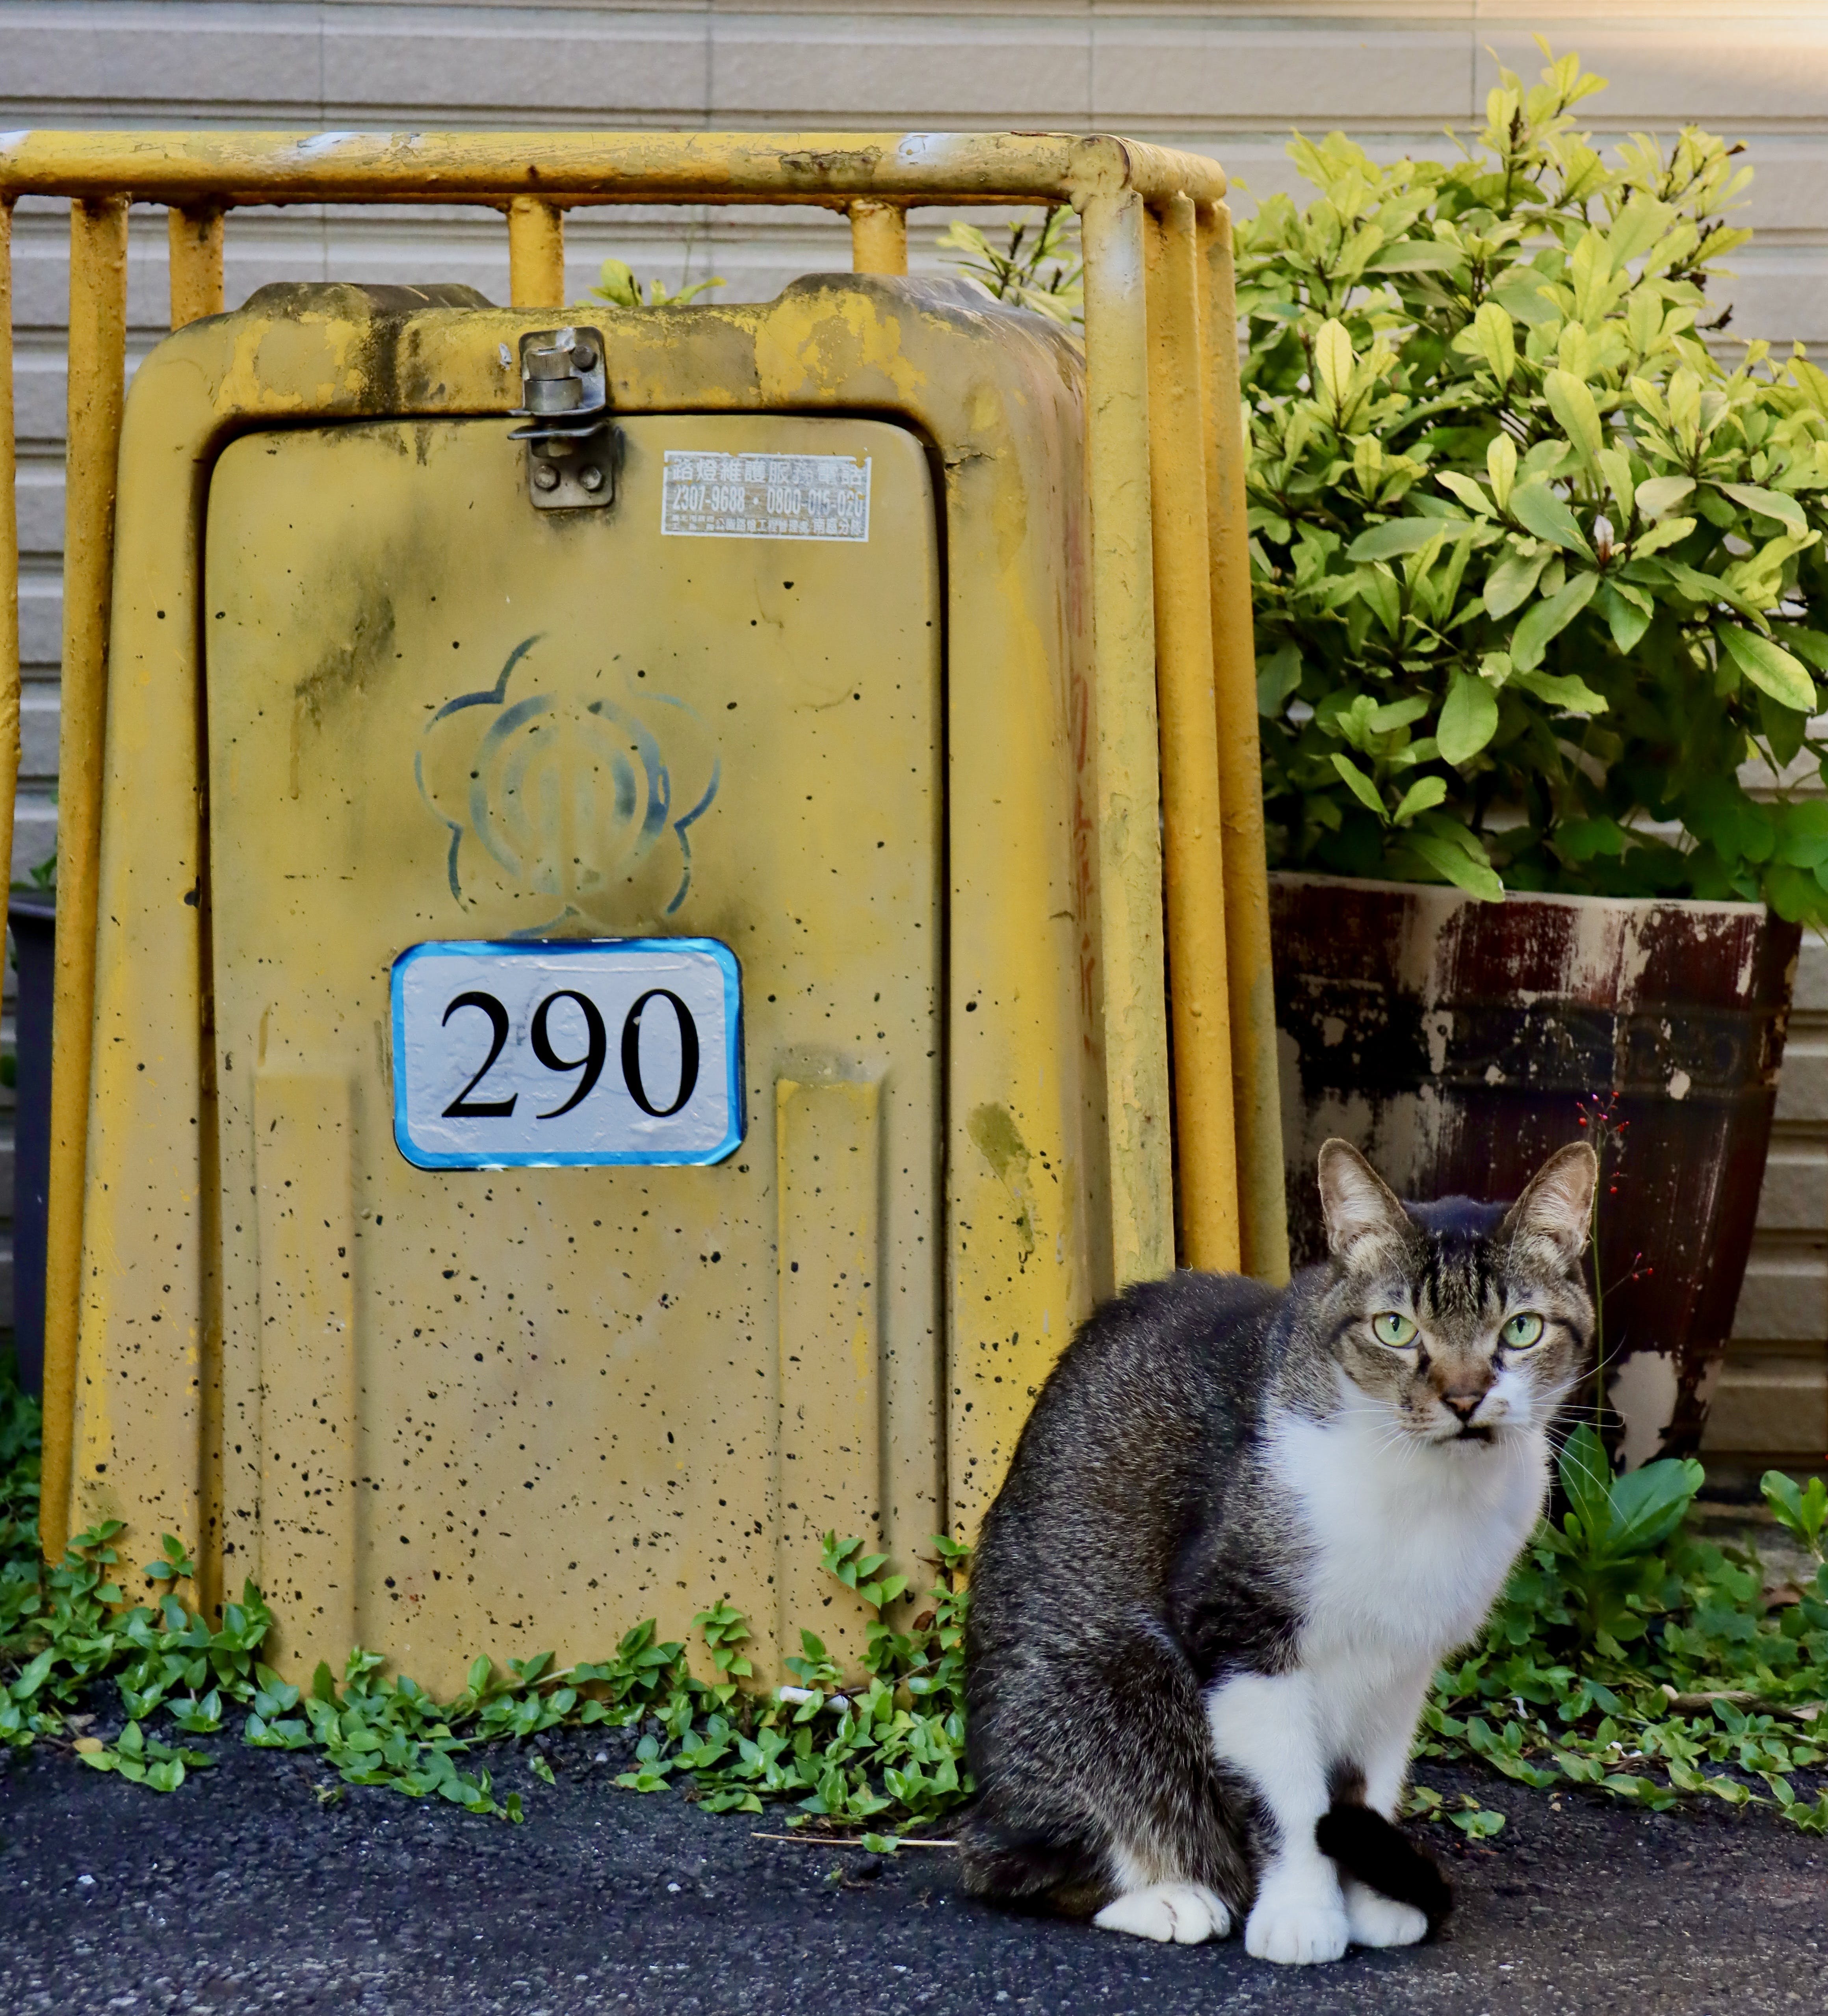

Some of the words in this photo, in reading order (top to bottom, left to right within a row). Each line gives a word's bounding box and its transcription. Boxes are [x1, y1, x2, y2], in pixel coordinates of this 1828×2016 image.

[673, 458, 862, 485] 路燈維護服務電話
[672, 485, 745, 513] 2307-9688
[767, 487, 862, 517] 0800-015-020
[442, 989, 699, 1119] 290
